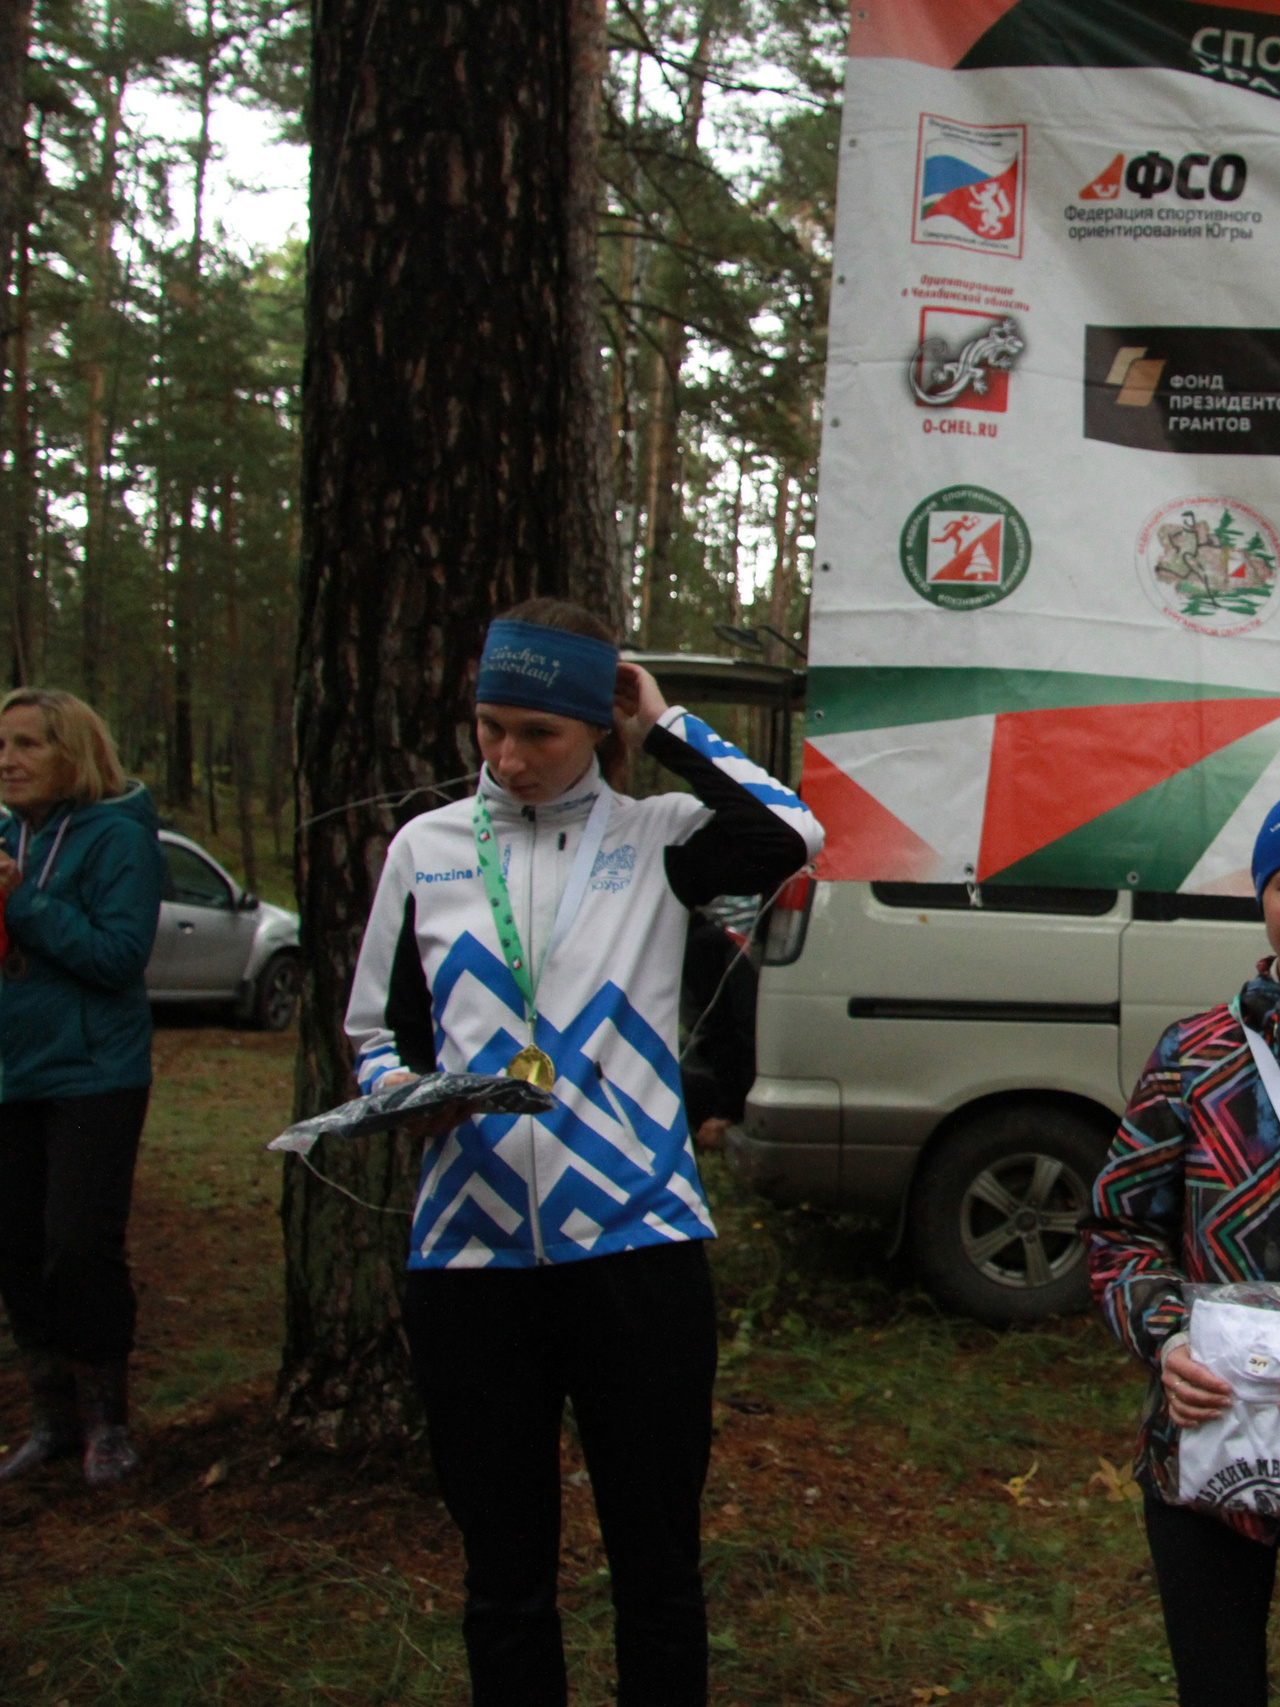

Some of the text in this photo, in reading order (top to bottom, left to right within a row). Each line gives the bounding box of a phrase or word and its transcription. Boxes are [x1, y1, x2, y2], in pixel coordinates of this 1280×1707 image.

[1124, 150, 1248, 202] ФСО
[1064, 205, 1263, 224] Федерация спортивного
[1068, 223, 1254, 242] ориентирования Югры
[1169, 374, 1224, 390] ФОНД
[1168, 416, 1252, 432] ГРАНТОВ
[415, 868, 473, 884] Penzina
[1194, 1457, 1254, 1504] ЬСКИЙ
